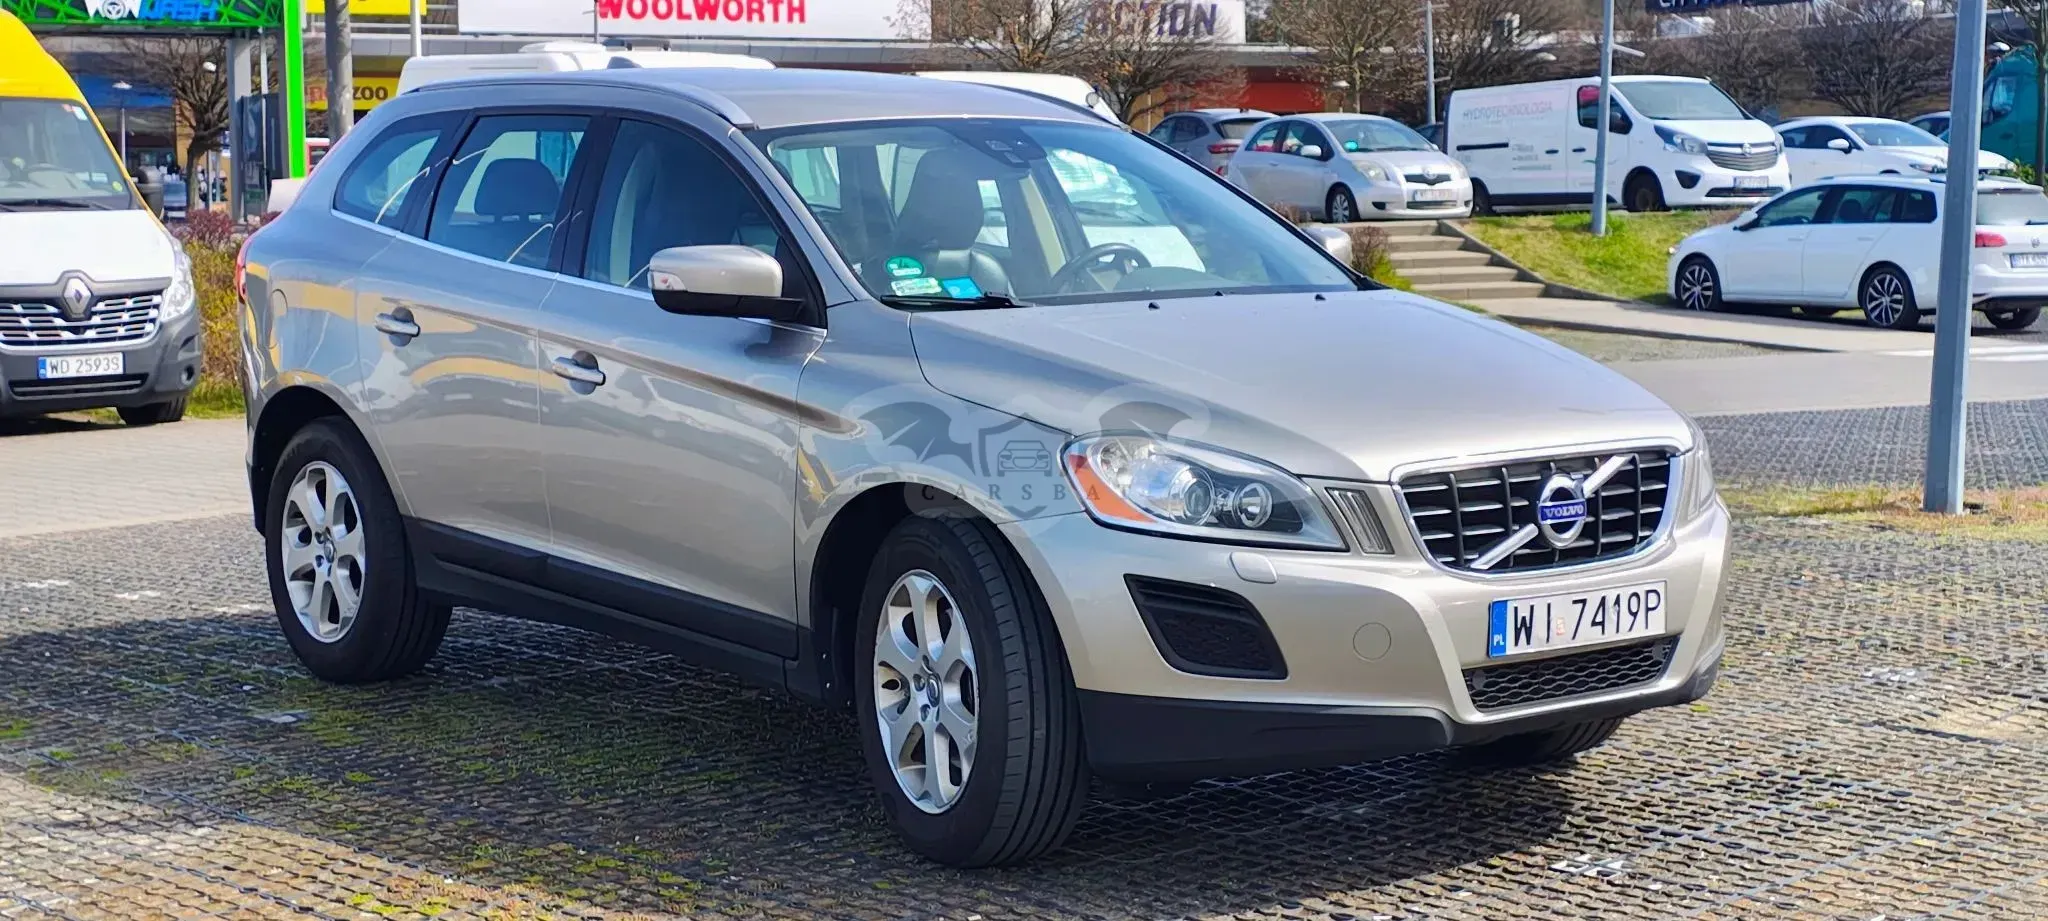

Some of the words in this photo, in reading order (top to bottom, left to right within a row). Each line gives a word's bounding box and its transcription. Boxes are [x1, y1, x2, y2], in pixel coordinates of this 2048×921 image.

[597, 0, 806, 24] WOOLWORTH
[50, 359, 70, 374] WD
[1543, 504, 1585, 518] VOLVO
[1513, 602, 1552, 647] WI
[1571, 589, 1662, 641] 7419P
[1493, 634, 1504, 646] PL
